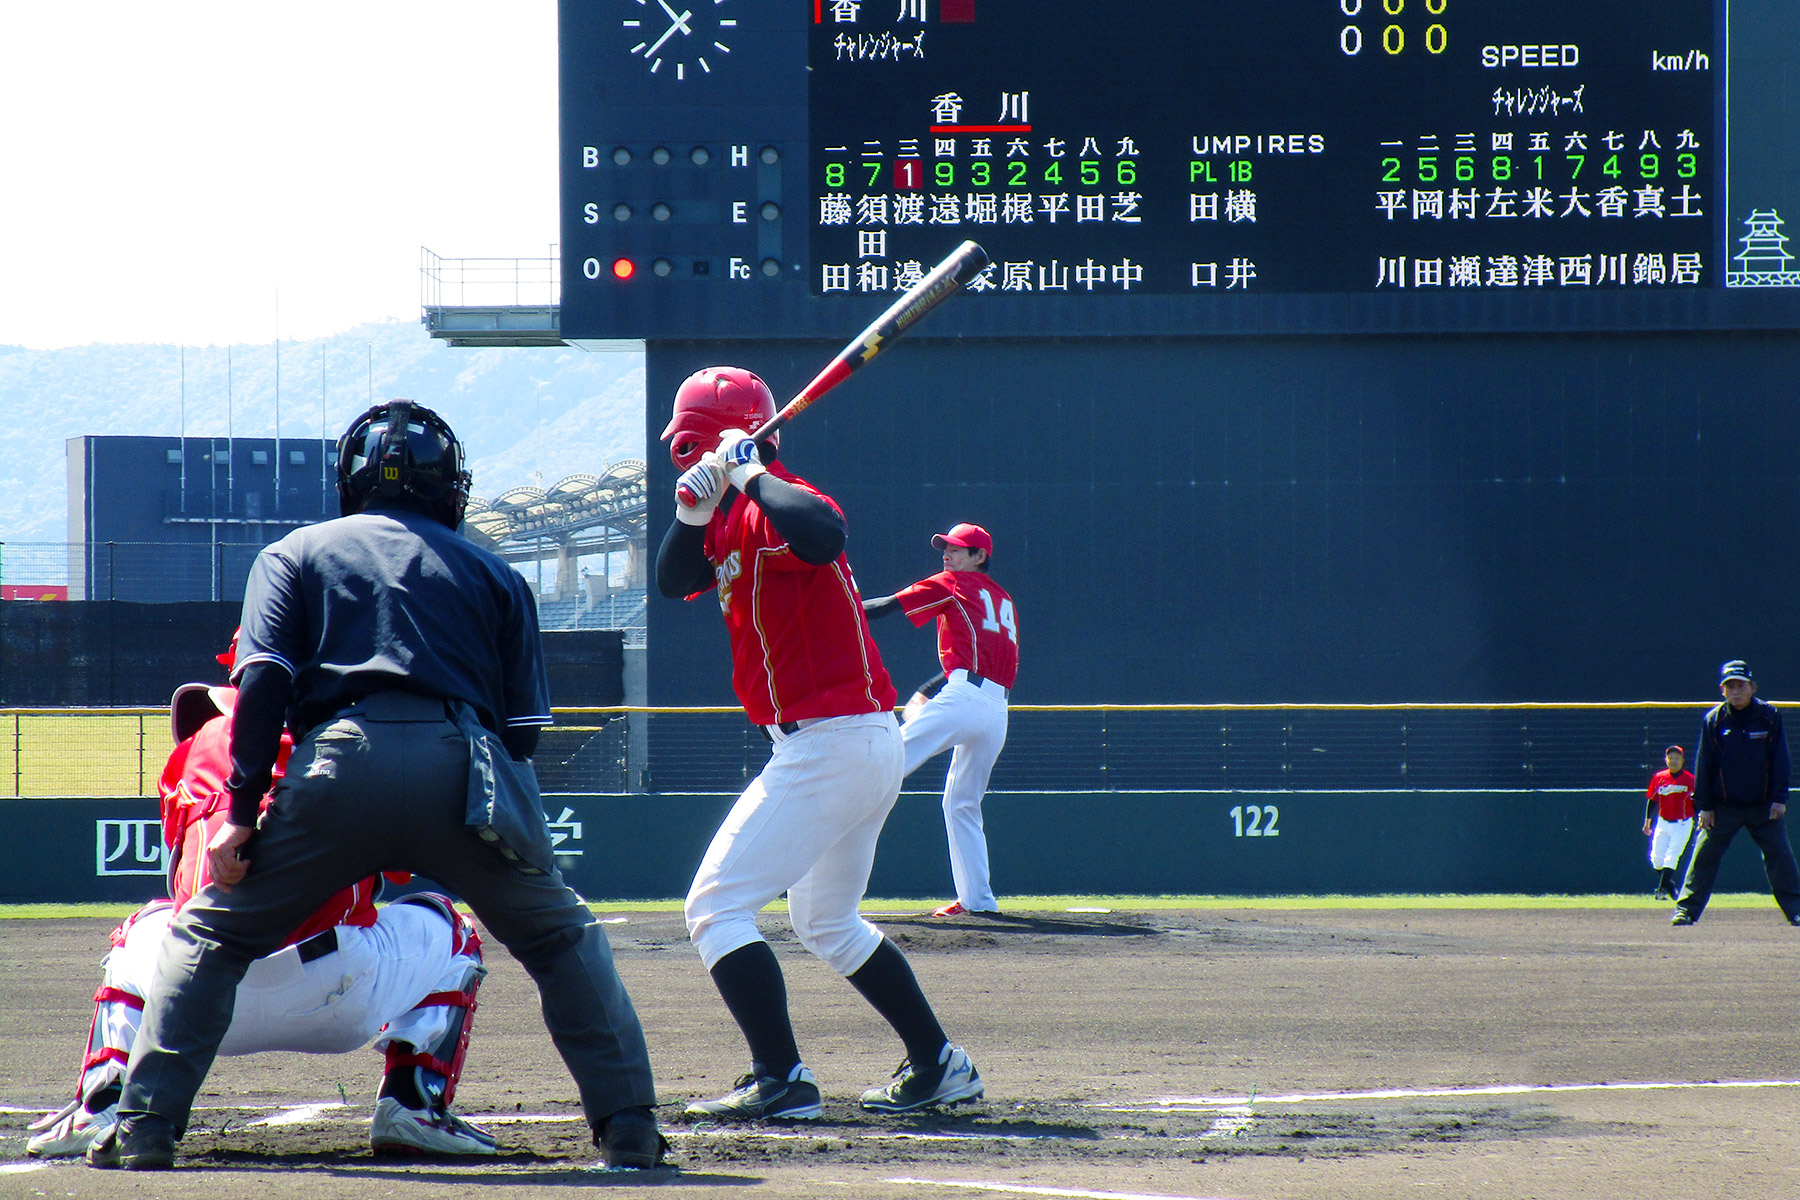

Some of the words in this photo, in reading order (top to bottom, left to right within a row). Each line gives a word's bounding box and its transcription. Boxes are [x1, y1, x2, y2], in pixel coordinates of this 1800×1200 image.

[834, 31, 925, 62] チャレンジャーズ
[1341, 26, 1361, 56] 0
[1383, 25, 1404, 54] 0
[1426, 24, 1446, 53] 0
[1482, 45, 1578, 68] SPEED
[1653, 50, 1708, 71] km/h
[931, 92, 1028, 123] 香川
[1492, 85, 1584, 116] チャレンジャーズ
[861, 141, 883, 156] 二
[898, 139, 920, 157] 三
[935, 139, 956, 157] 四
[970, 138, 992, 157] 五
[1007, 138, 1029, 157] 六
[1043, 138, 1065, 157] 七
[1080, 137, 1101, 157] 八
[1116, 137, 1139, 157] 九
[1193, 135, 1324, 155] UMPIRES
[1417, 135, 1439, 150] 二
[1454, 133, 1476, 151] 三
[1492, 133, 1513, 151] 四
[1528, 132, 1550, 151] 五
[1565, 131, 1587, 151] 六
[1602, 131, 1624, 151] 七
[1639, 130, 1661, 150] 八
[1676, 129, 1699, 150] 九
[583, 147, 598, 169] B
[732, 146, 747, 167] H
[1382, 158, 1400, 181] 2
[1419, 157, 1437, 181] 5
[1456, 157, 1473, 180] 6
[1493, 156, 1511, 180] 8
[1534, 156, 1542, 179] 1
[1567, 155, 1584, 179] 7
[1604, 155, 1621, 178] 4
[1641, 154, 1658, 178] 9
[1678, 154, 1696, 177] 3
[826, 164, 844, 186] 8
[863, 163, 880, 186] 7
[903, 163, 911, 186] 1
[936, 163, 953, 185] 9
[972, 162, 989, 185] 3
[1008, 162, 1026, 185] 2
[1045, 162, 1062, 184] 4
[1081, 161, 1099, 184] 5
[1118, 161, 1135, 184] 6
[1191, 161, 1217, 182] PL
[1229, 161, 1252, 181] 1B
[584, 203, 598, 224] S
[733, 202, 746, 224] E
[978, 588, 1017, 646] 14
[1229, 804, 1280, 838] 122
